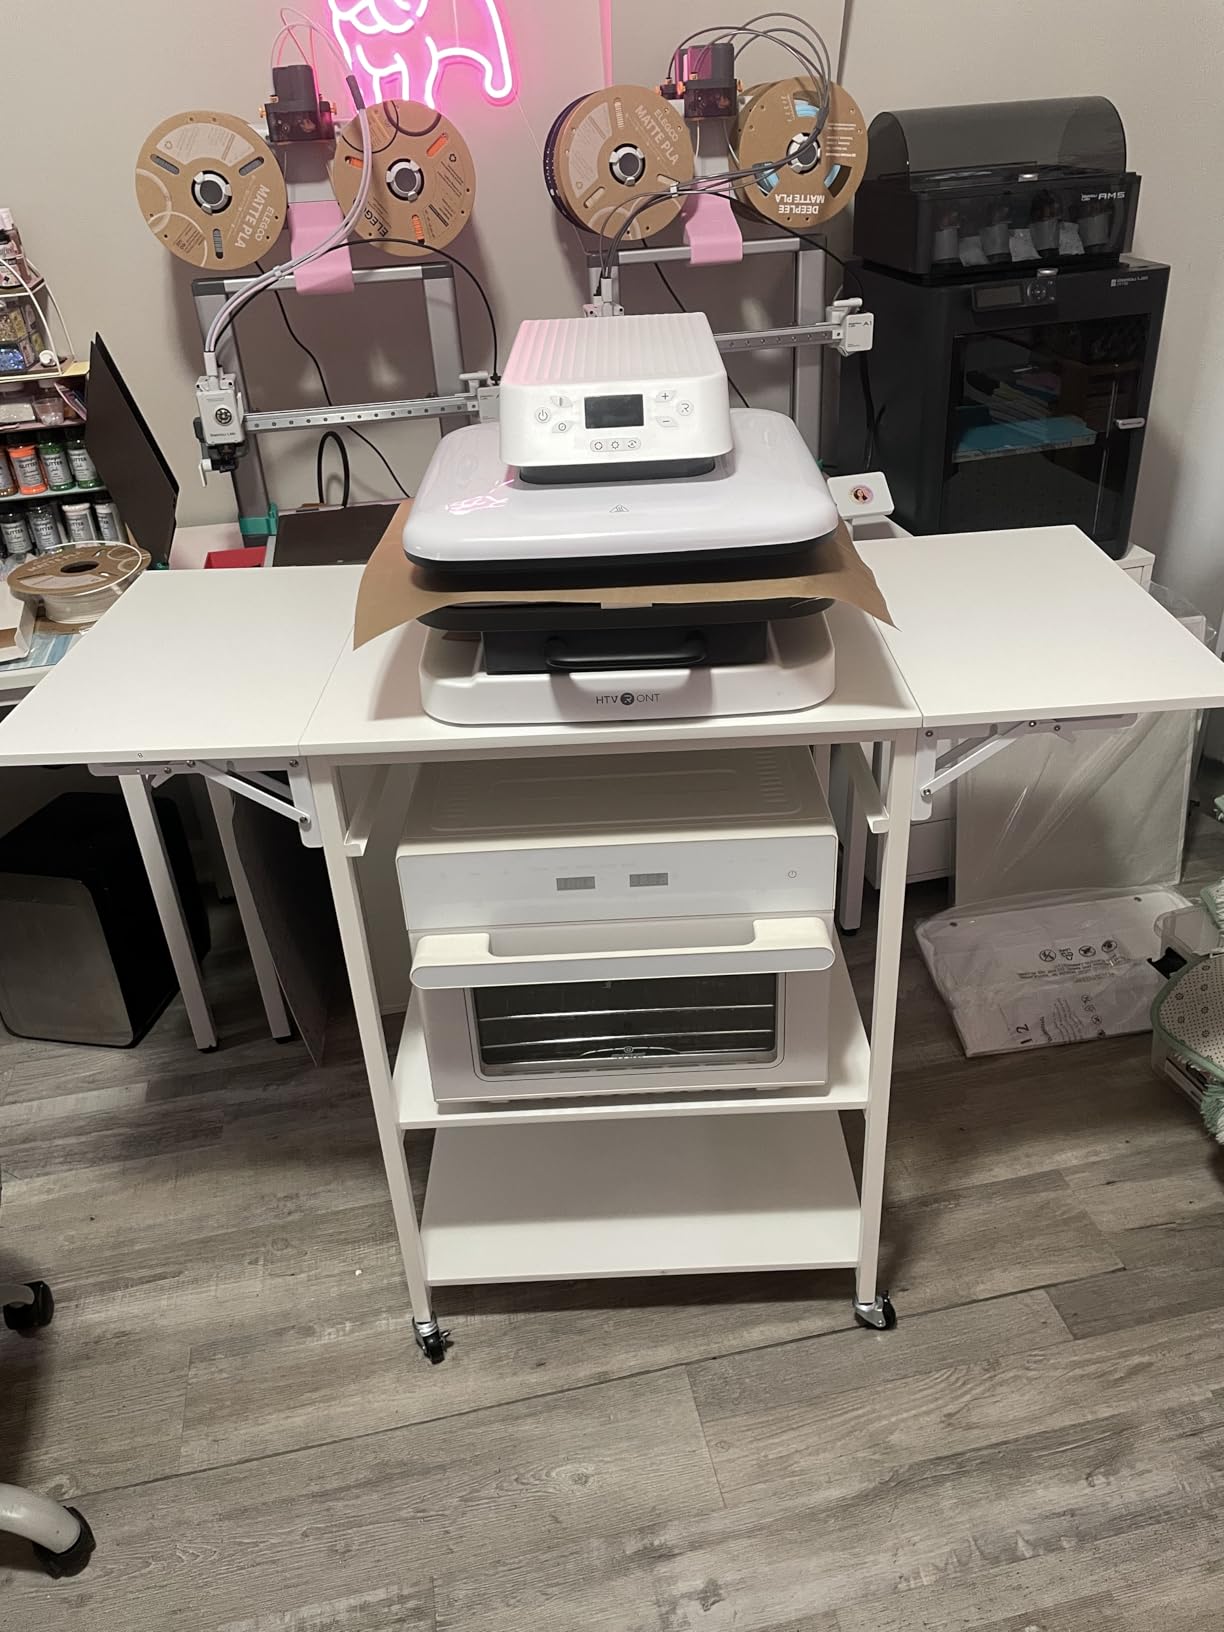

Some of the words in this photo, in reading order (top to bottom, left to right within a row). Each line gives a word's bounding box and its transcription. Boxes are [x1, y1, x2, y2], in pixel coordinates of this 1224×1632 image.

[635, 104, 665, 144] MATTE
[661, 140, 679, 165] PLA
[654, 109, 679, 142] ELEGOO
[245, 184, 271, 226] MATTE
[775, 193, 793, 203] PLA
[778, 204, 819, 214] DEEPLEE
[793, 194, 825, 204] MATTE
[1098, 191, 1125, 200] AMS
[255, 206, 275, 241] ELEGOO
[363, 207, 389, 237] ELEG
[234, 224, 253, 248] PLA
